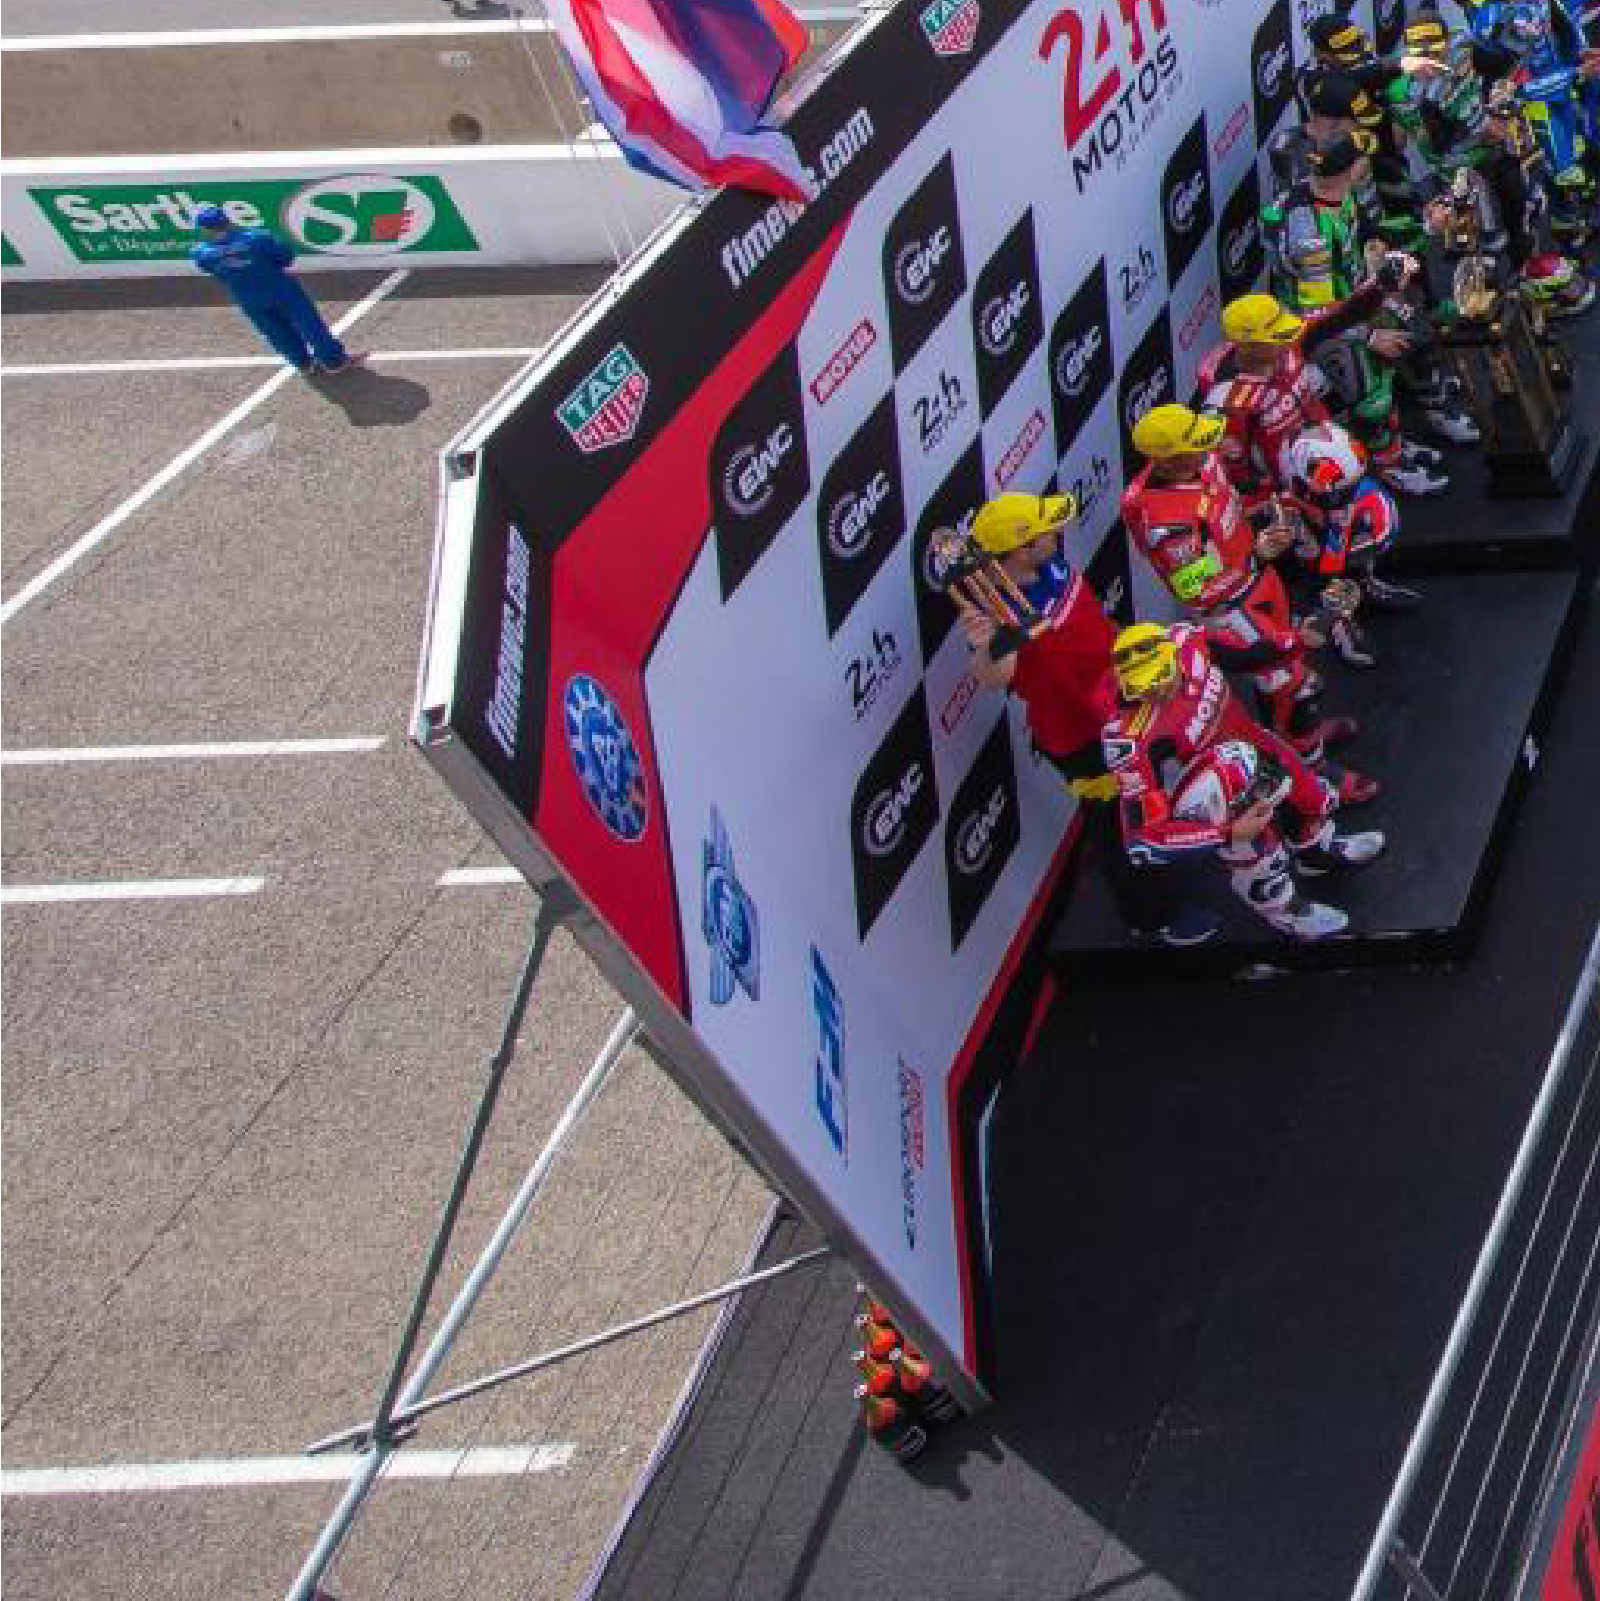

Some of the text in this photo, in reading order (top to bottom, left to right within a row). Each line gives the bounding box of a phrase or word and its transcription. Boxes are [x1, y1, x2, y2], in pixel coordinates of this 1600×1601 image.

[1071, 33, 1178, 195] MOTOS
[904, 224, 952, 291] EWC
[562, 349, 634, 422] TAG
[737, 422, 794, 501] EWC
[840, 470, 891, 545] EWC
[874, 761, 924, 842] EWC
